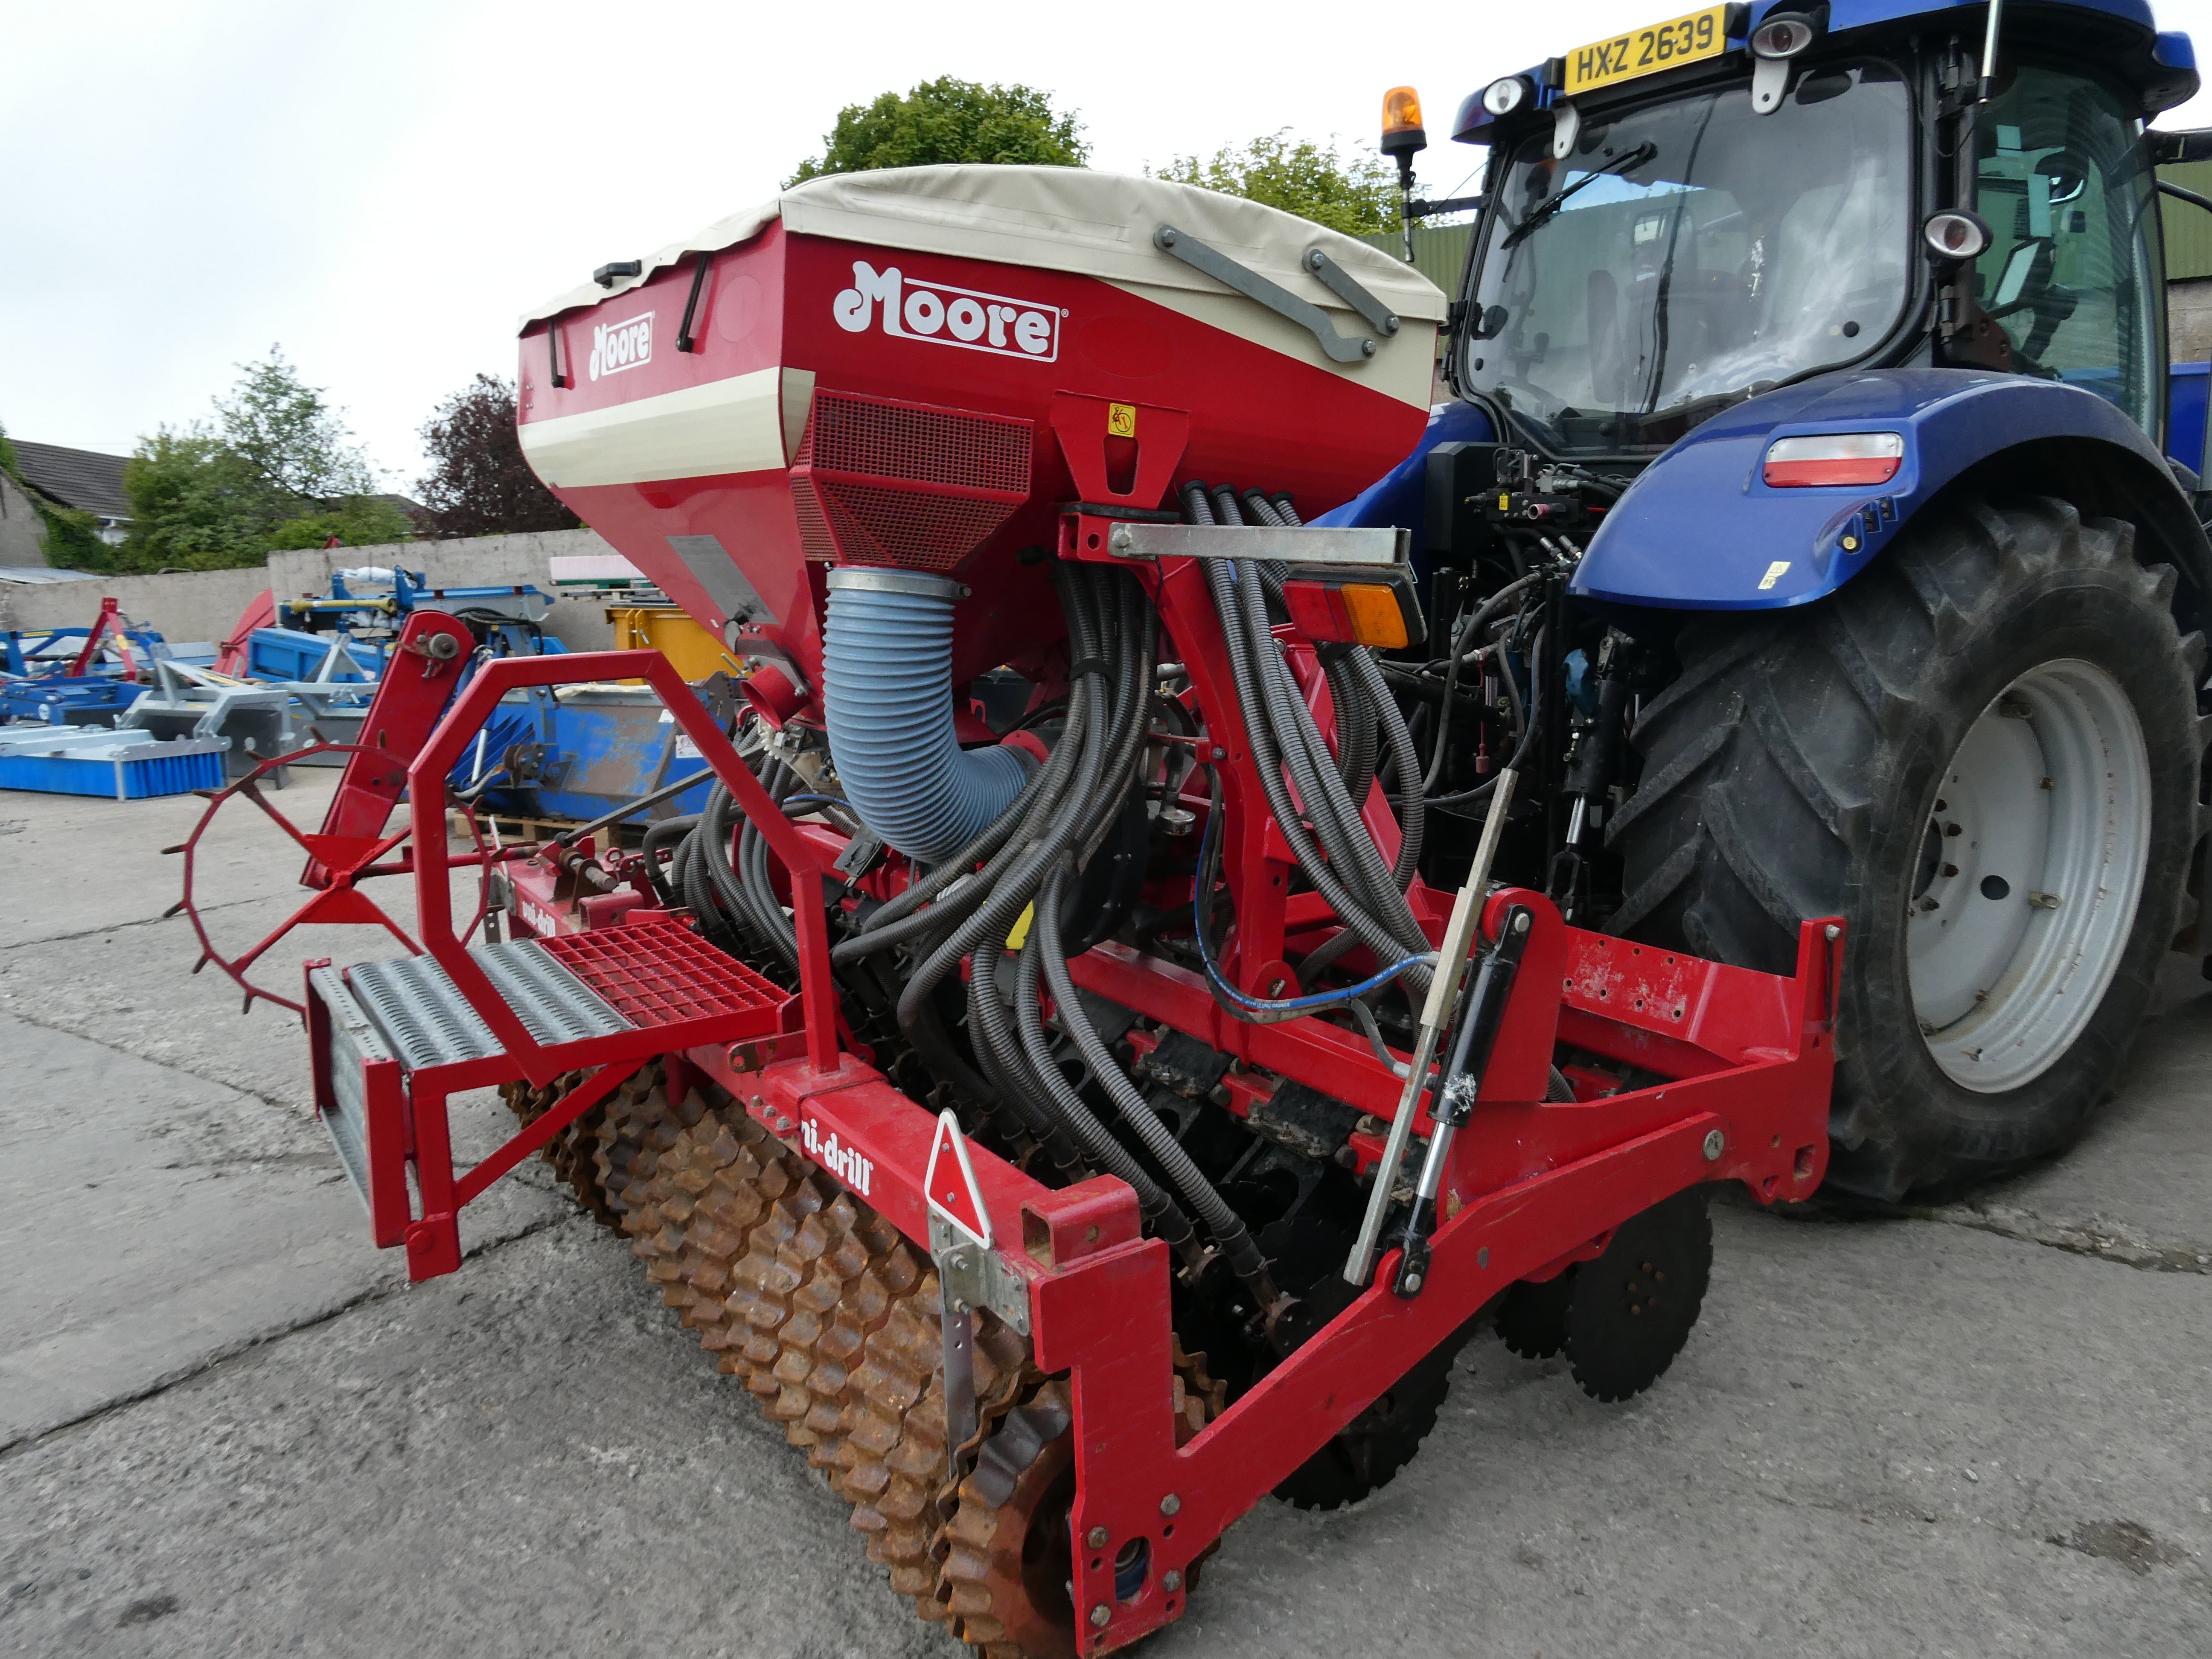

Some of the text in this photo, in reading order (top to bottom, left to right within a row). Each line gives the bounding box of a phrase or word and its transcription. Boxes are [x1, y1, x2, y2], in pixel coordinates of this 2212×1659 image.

[1577, 14, 1714, 83] HXZ 2639
[833, 261, 1051, 354] Moore
[590, 323, 649, 381] Moore
[801, 1118, 870, 1196] ni-drill
